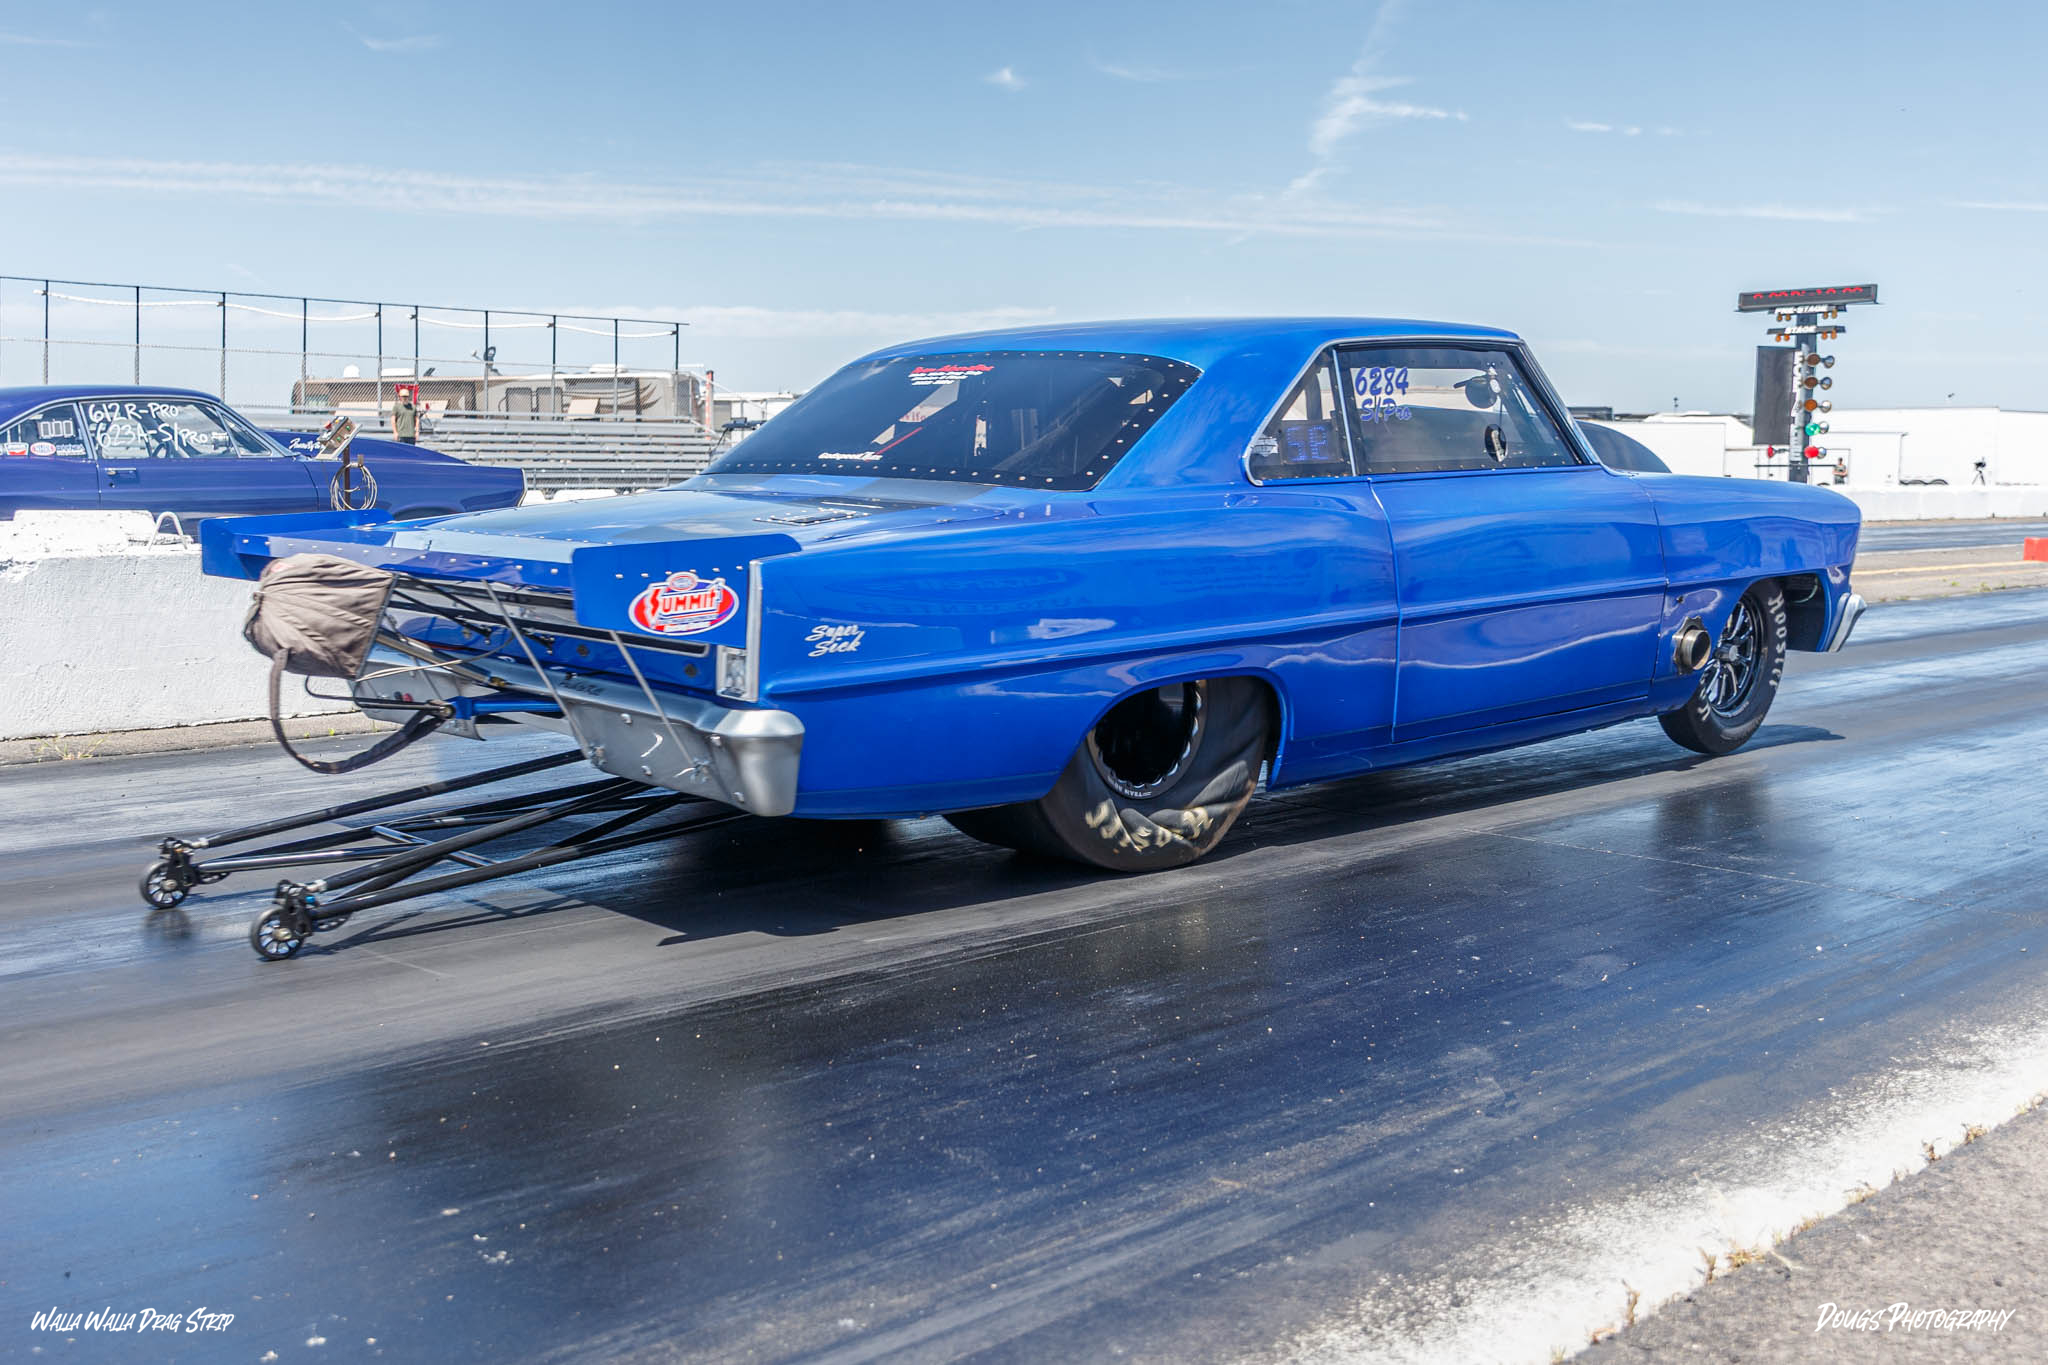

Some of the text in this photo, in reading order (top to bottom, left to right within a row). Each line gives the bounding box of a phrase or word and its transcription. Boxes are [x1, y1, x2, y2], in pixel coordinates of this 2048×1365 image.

[1355, 366, 1409, 396] 6284
[804, 624, 861, 642] Super
[808, 631, 865, 657] Sick
